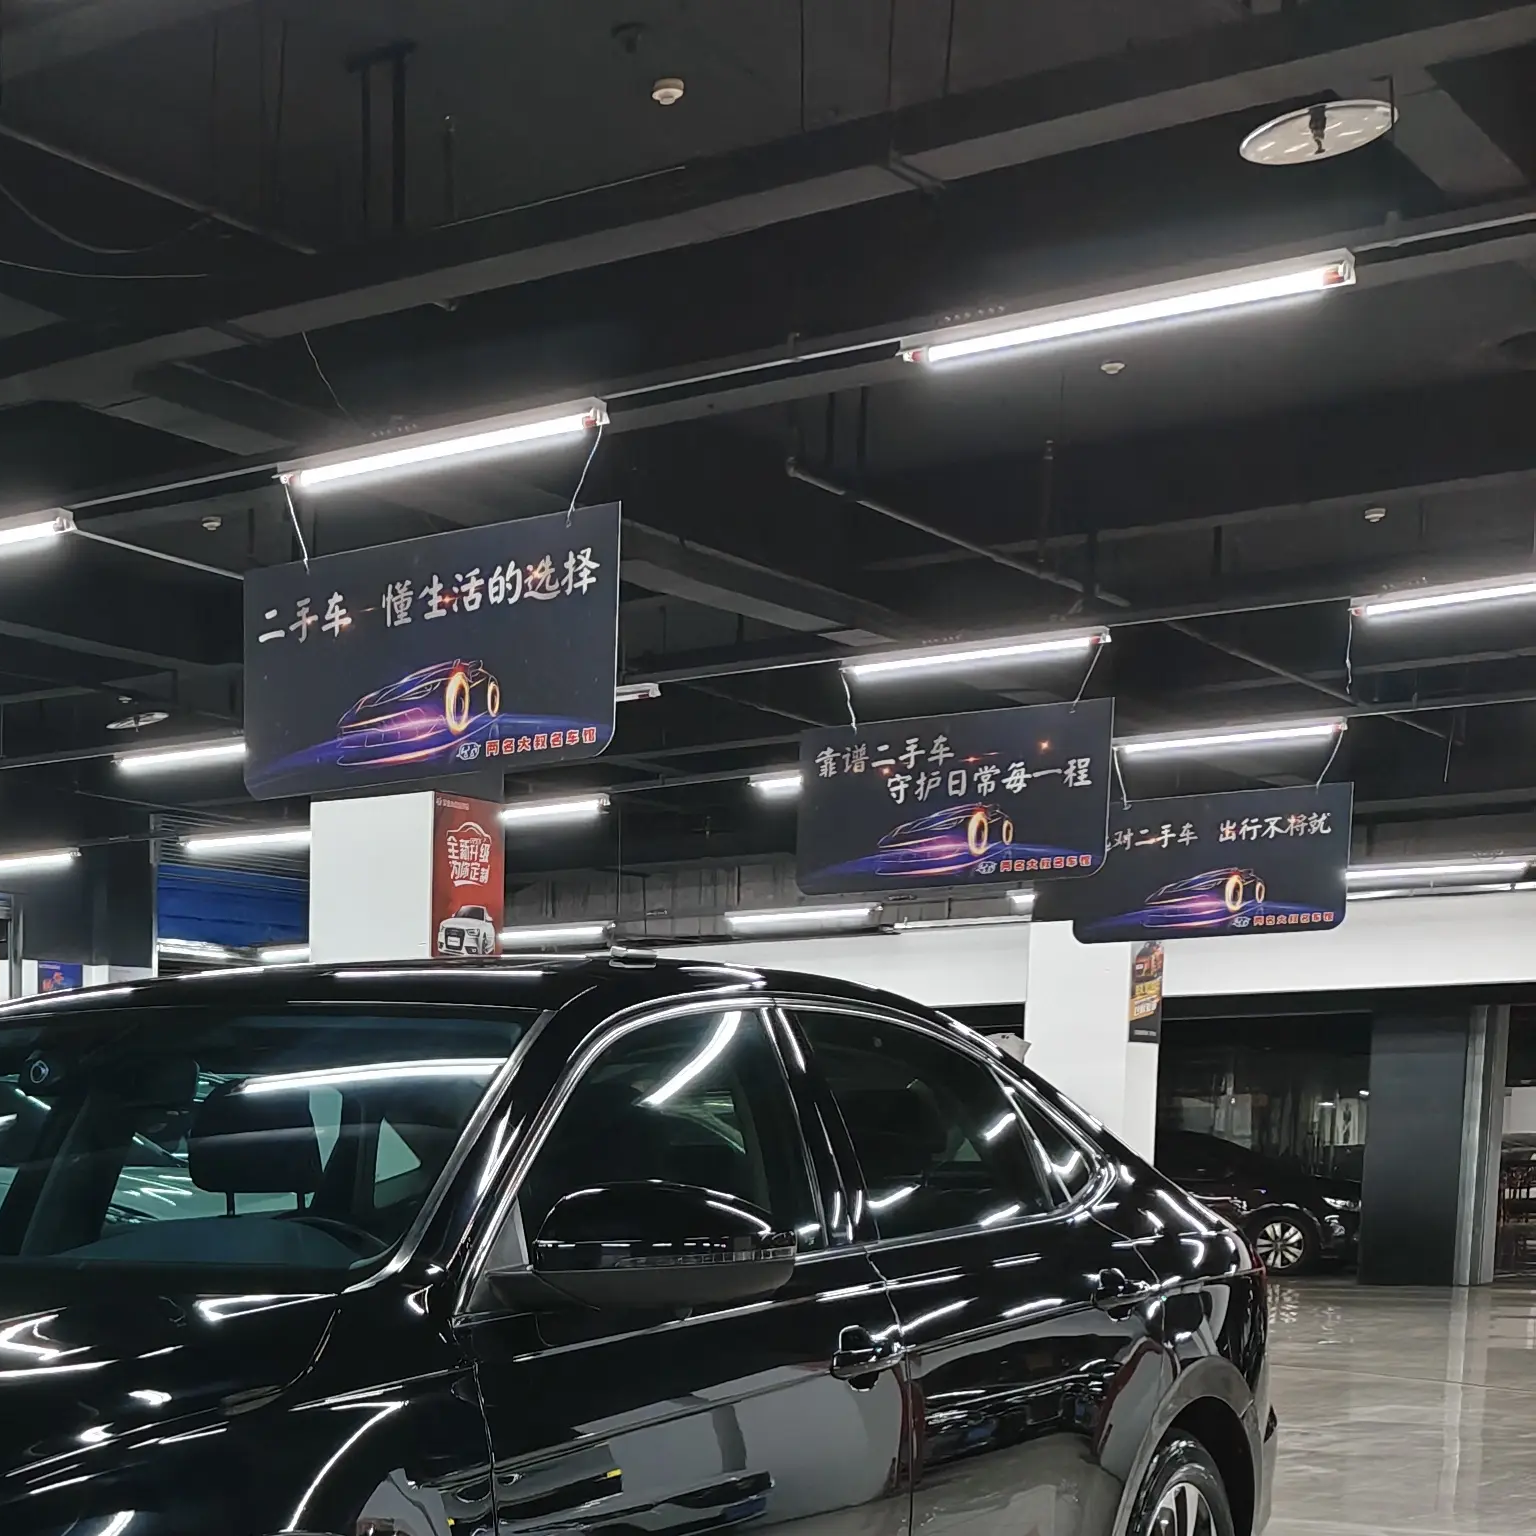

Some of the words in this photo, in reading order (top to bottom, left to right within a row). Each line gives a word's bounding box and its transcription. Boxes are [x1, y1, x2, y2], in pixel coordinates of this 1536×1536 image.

[258, 591, 352, 644] 二手车
[382, 547, 601, 628] 懂生活的选择
[485, 727, 596, 757] 两名大叔名车馆
[815, 734, 955, 778] 靠谱二手车
[886, 757, 1093, 805] 守护日常每一程
[1218, 812, 1332, 843] 出行不将就
